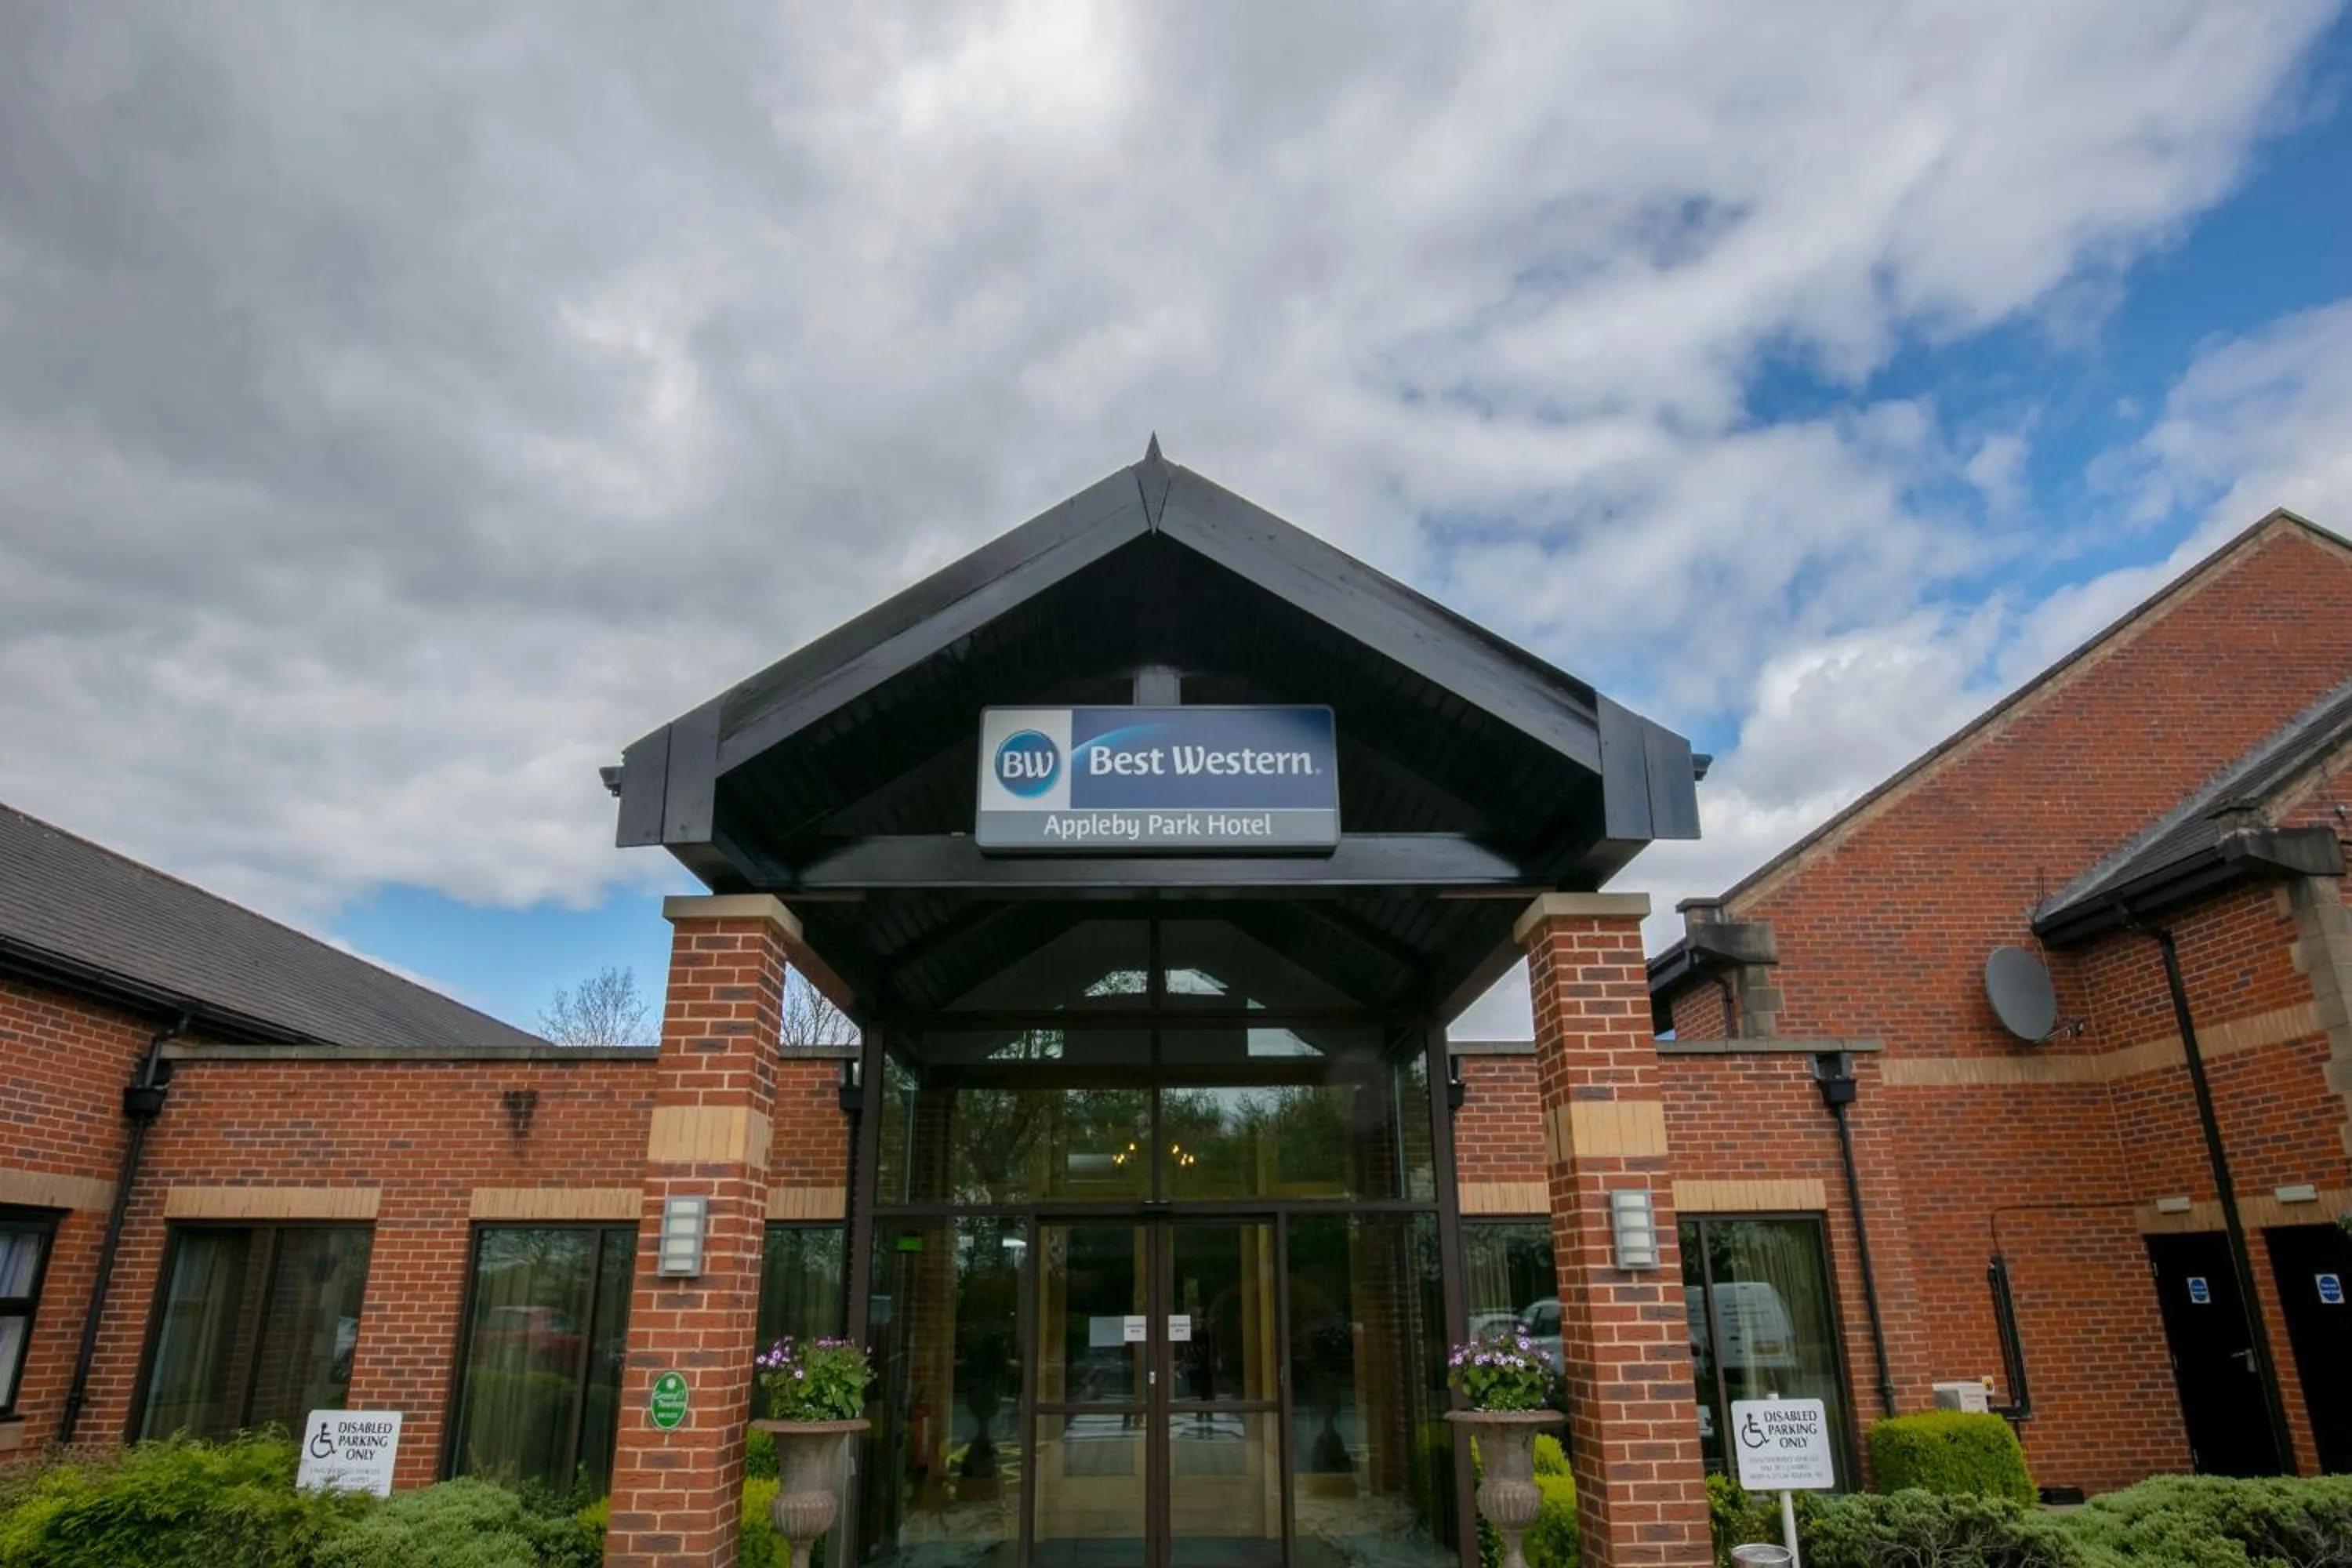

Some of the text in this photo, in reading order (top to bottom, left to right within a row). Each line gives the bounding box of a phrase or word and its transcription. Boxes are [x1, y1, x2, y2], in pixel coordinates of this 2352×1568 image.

[1004, 751, 1054, 779] BW
[1090, 746, 1165, 775] Best
[1044, 813, 1272, 840] Appleby Park Hotel
[1763, 1410, 1817, 1422] DISABLED
[338, 1421, 392, 1433] DISABLED
[1768, 1423, 1817, 1435] PARKING
[338, 1436, 388, 1447] PARKING
[1779, 1436, 1809, 1448] ONLY
[346, 1448, 376, 1460] ONLY
